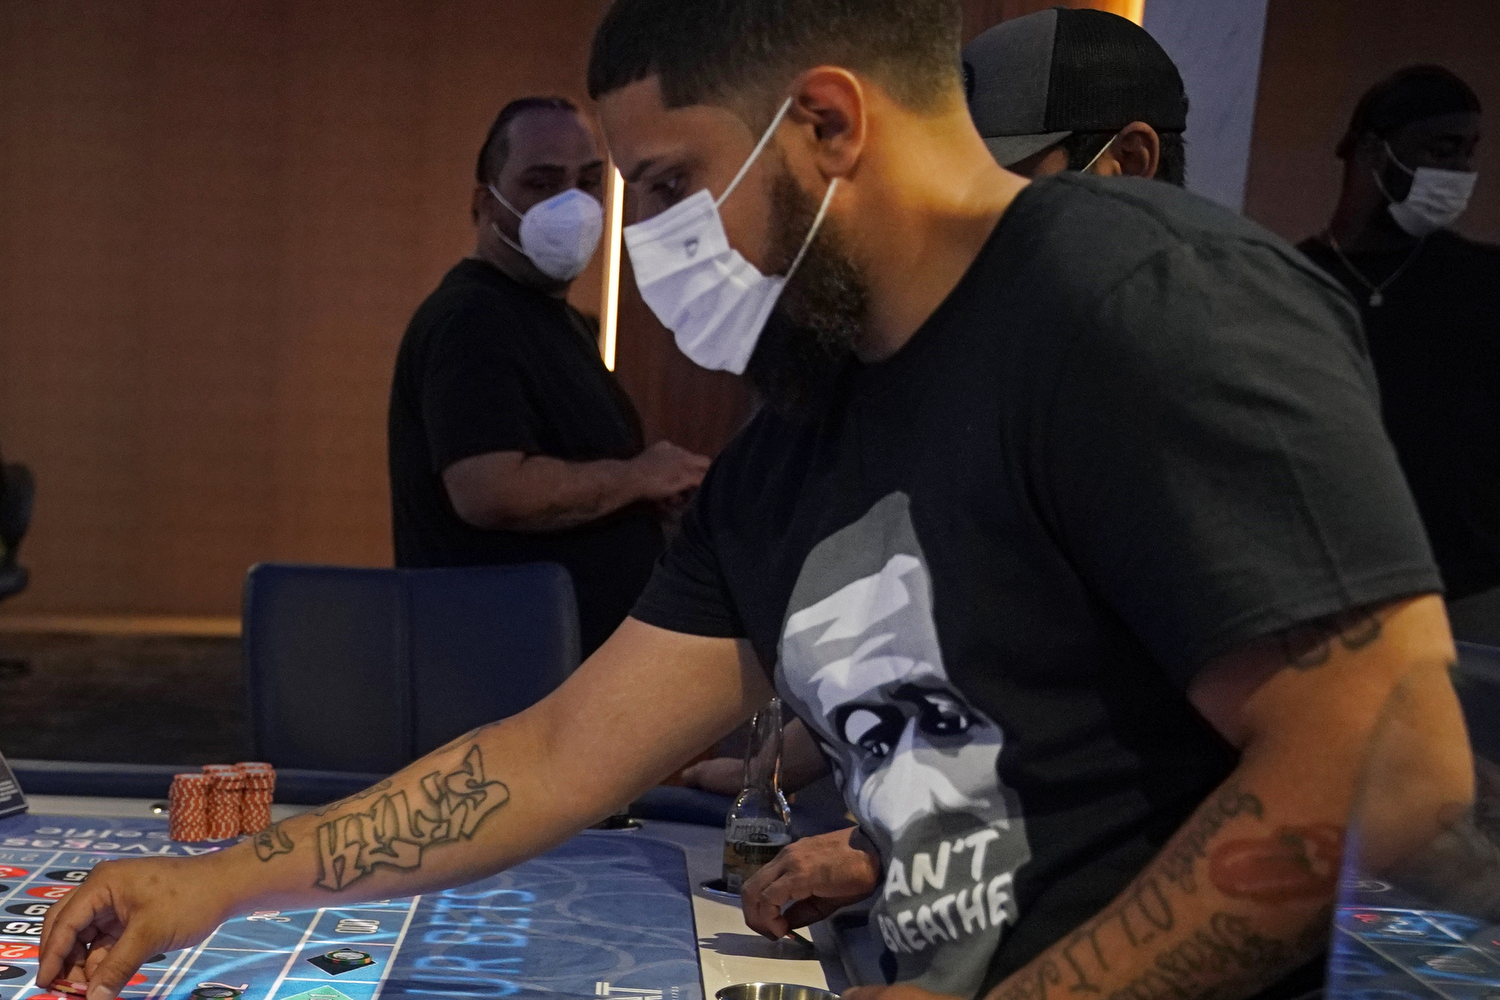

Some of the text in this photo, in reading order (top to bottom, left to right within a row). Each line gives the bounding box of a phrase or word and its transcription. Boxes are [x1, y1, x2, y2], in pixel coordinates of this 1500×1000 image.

[884, 829, 1000, 901] AN'T
[62, 869, 90, 882] 5
[43, 886, 71, 899] 2
[23, 903, 50, 916] 9
[423, 888, 536, 949] BETS
